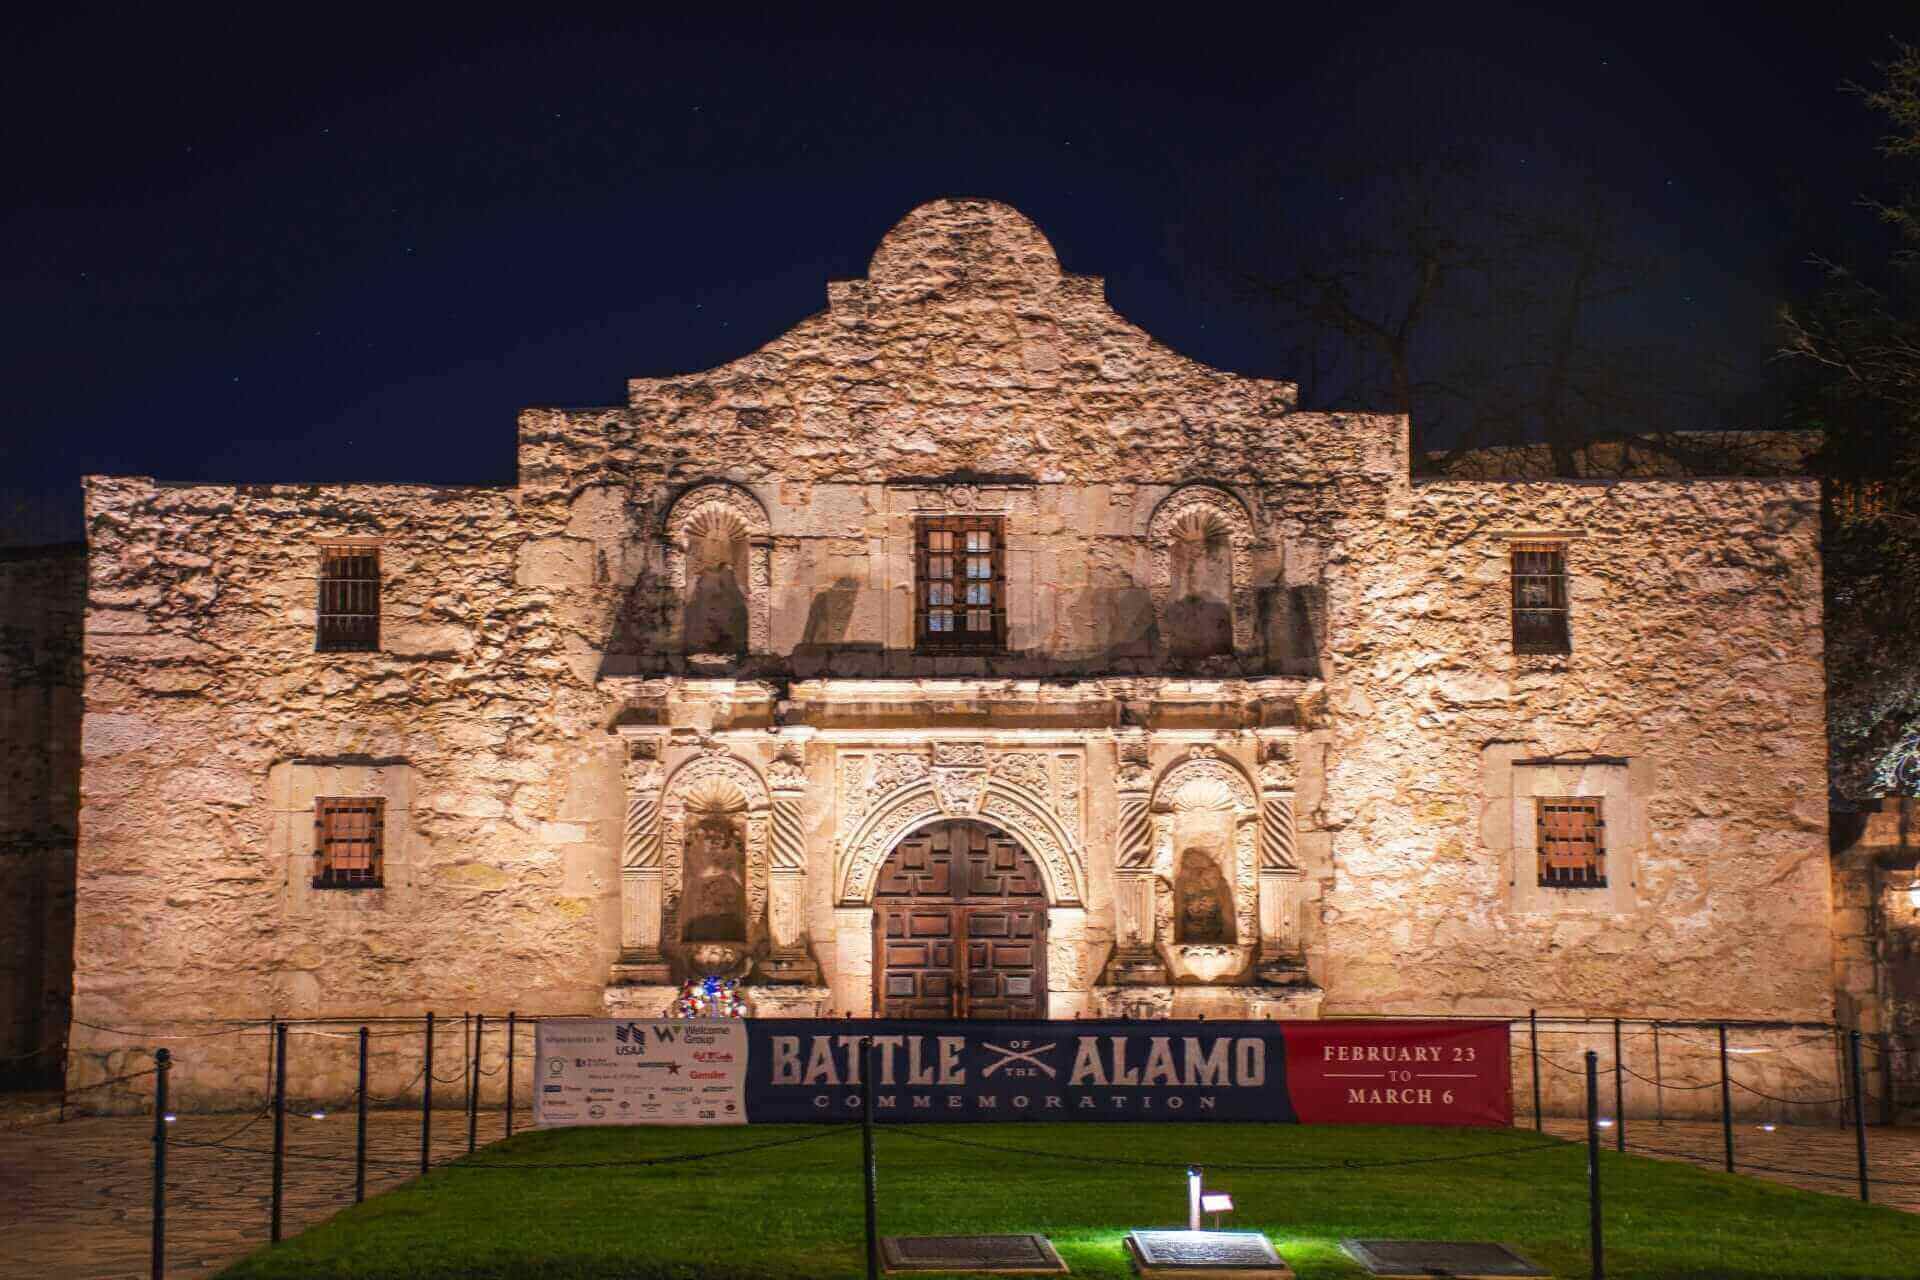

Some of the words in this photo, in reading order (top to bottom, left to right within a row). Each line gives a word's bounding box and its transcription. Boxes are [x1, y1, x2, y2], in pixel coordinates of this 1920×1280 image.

[685, 1025, 729, 1036] Welcome
[615, 1045, 645, 1056] USAA
[1009, 1040, 1032, 1049] OF
[771, 1035, 966, 1086] BATTLE
[1323, 1046, 1443, 1062] FEBRUARY
[1453, 1047, 1476, 1062] 23
[1068, 1036, 1266, 1087] ALAMO
[1005, 1067, 1037, 1077] THE
[1388, 1070, 1412, 1082] TO
[813, 1095, 1217, 1109] COMMEMORATION
[1348, 1088, 1433, 1104] MARCH
[1442, 1089, 1454, 1104] 6
